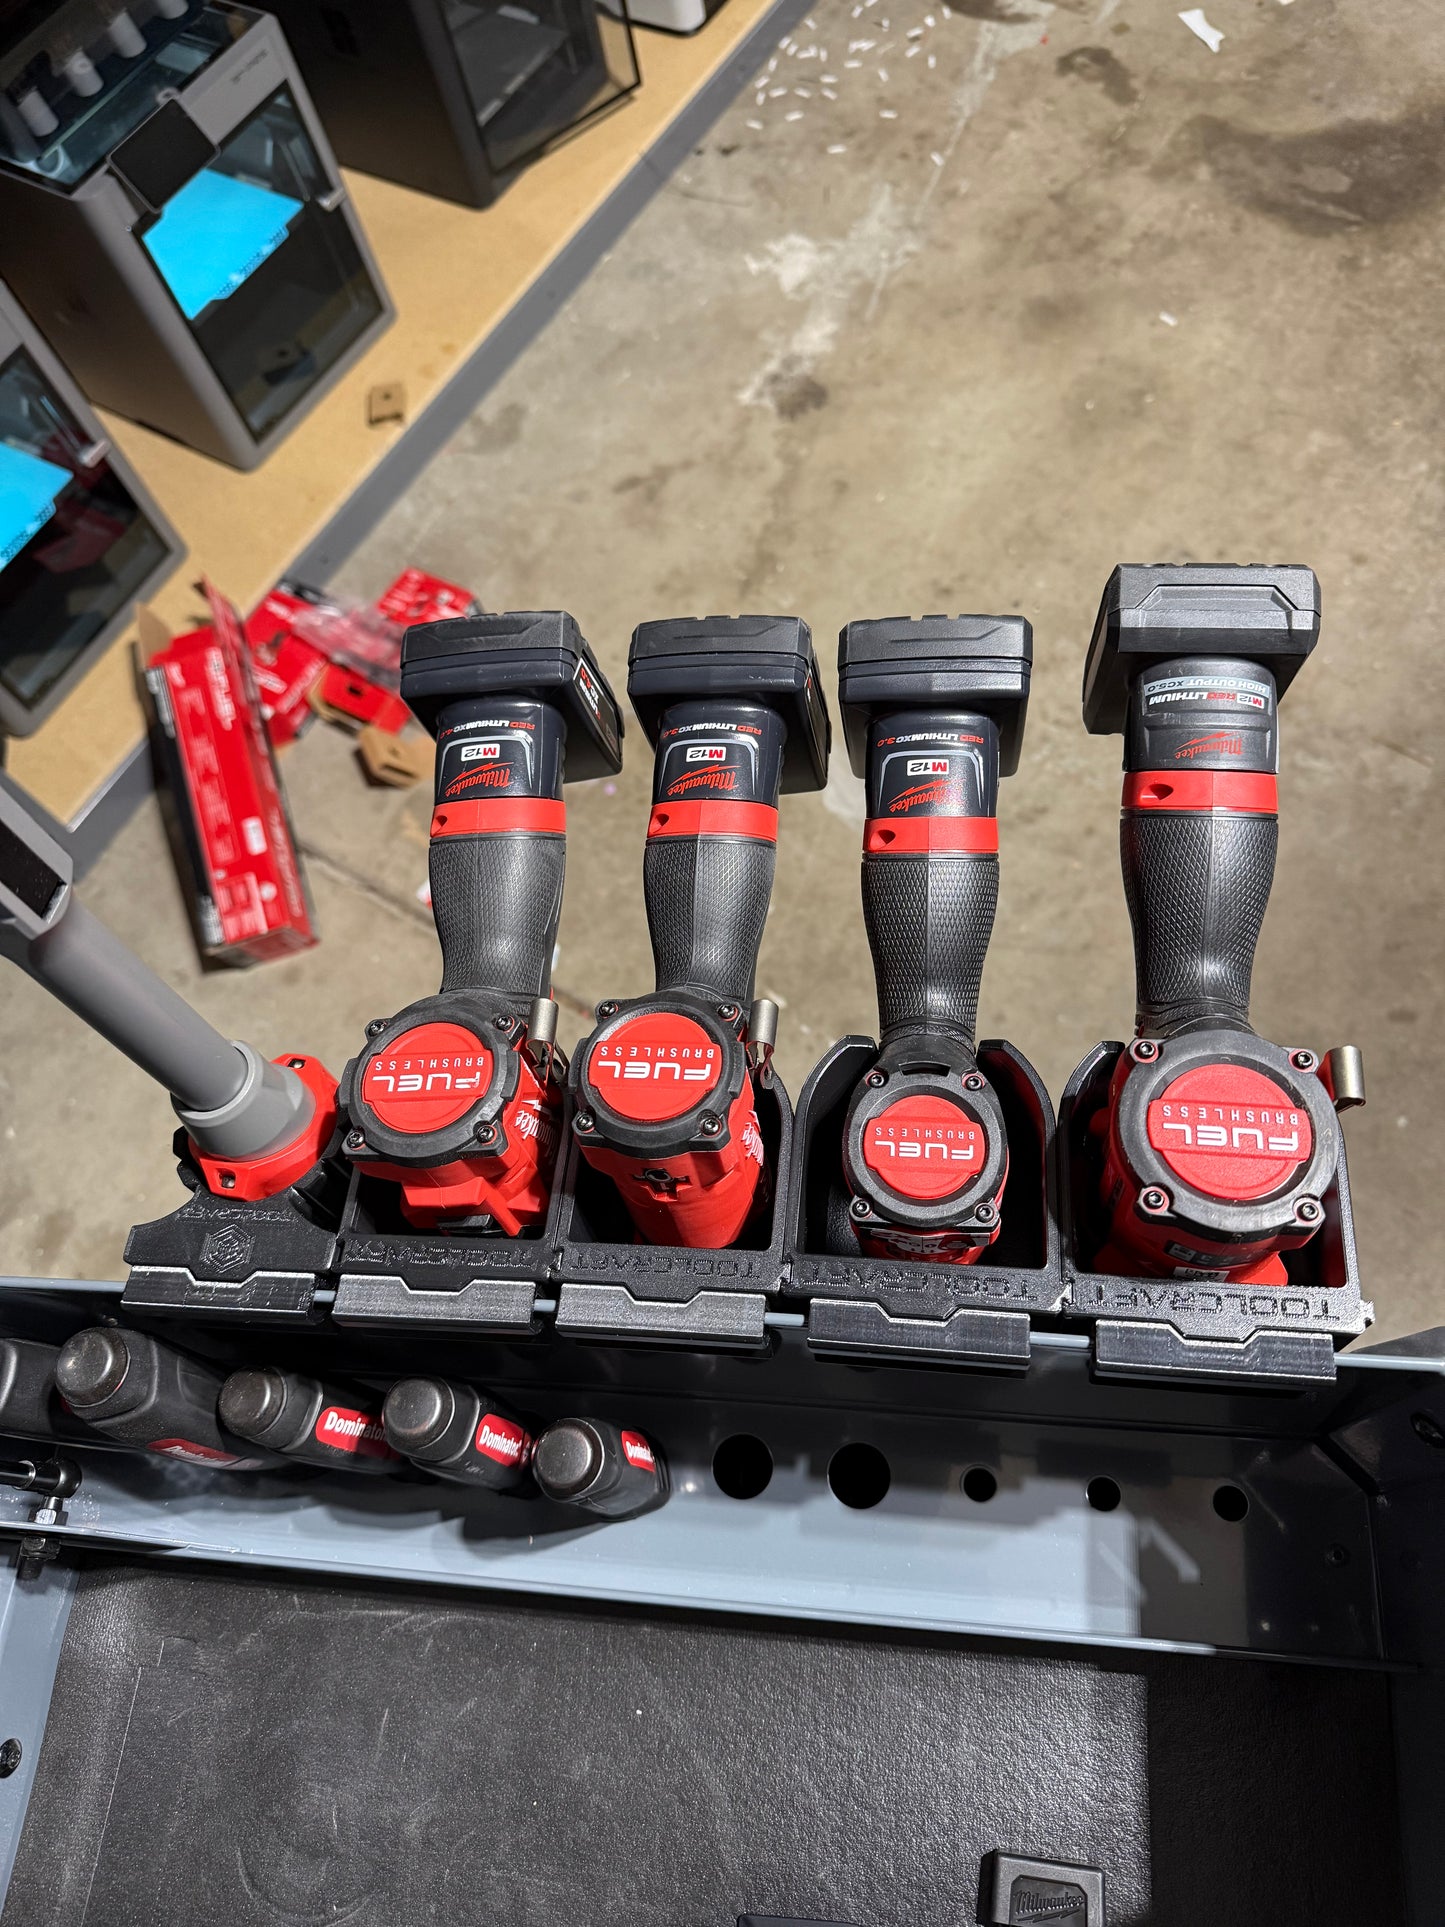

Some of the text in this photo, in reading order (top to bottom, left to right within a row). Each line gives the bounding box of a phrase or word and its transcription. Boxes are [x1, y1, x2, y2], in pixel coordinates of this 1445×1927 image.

[1187, 678, 1237, 687] OUTPUT
[1238, 681, 1266, 693] HIGH
[1239, 694, 1263, 707] M12
[463, 747, 497, 758] M12
[689, 748, 724, 760] M12
[1175, 736, 1245, 760] Milwaukee
[910, 761, 948, 773] M12
[444, 768, 515, 797] Milwaukee
[667, 770, 740, 797] Milwaukee
[600, 1046, 715, 1059] BRUSHLESS
[374, 1056, 484, 1071] BRUSHLESS
[597, 1060, 712, 1081] FUEL
[372, 1071, 481, 1093] FUEL
[1162, 1104, 1299, 1126] BRUSHLESS
[875, 1127, 976, 1140] BRUSHLESS
[1162, 1122, 1299, 1152] FUEL
[874, 1140, 974, 1161] FUEL
[570, 1252, 760, 1280] TOOLCRAFT
[804, 1264, 1038, 1301] TOOLCRAFT
[1086, 1283, 1341, 1323] TOOLCRAFT
[1014, 1889, 1085, 1915] Milwaukee
